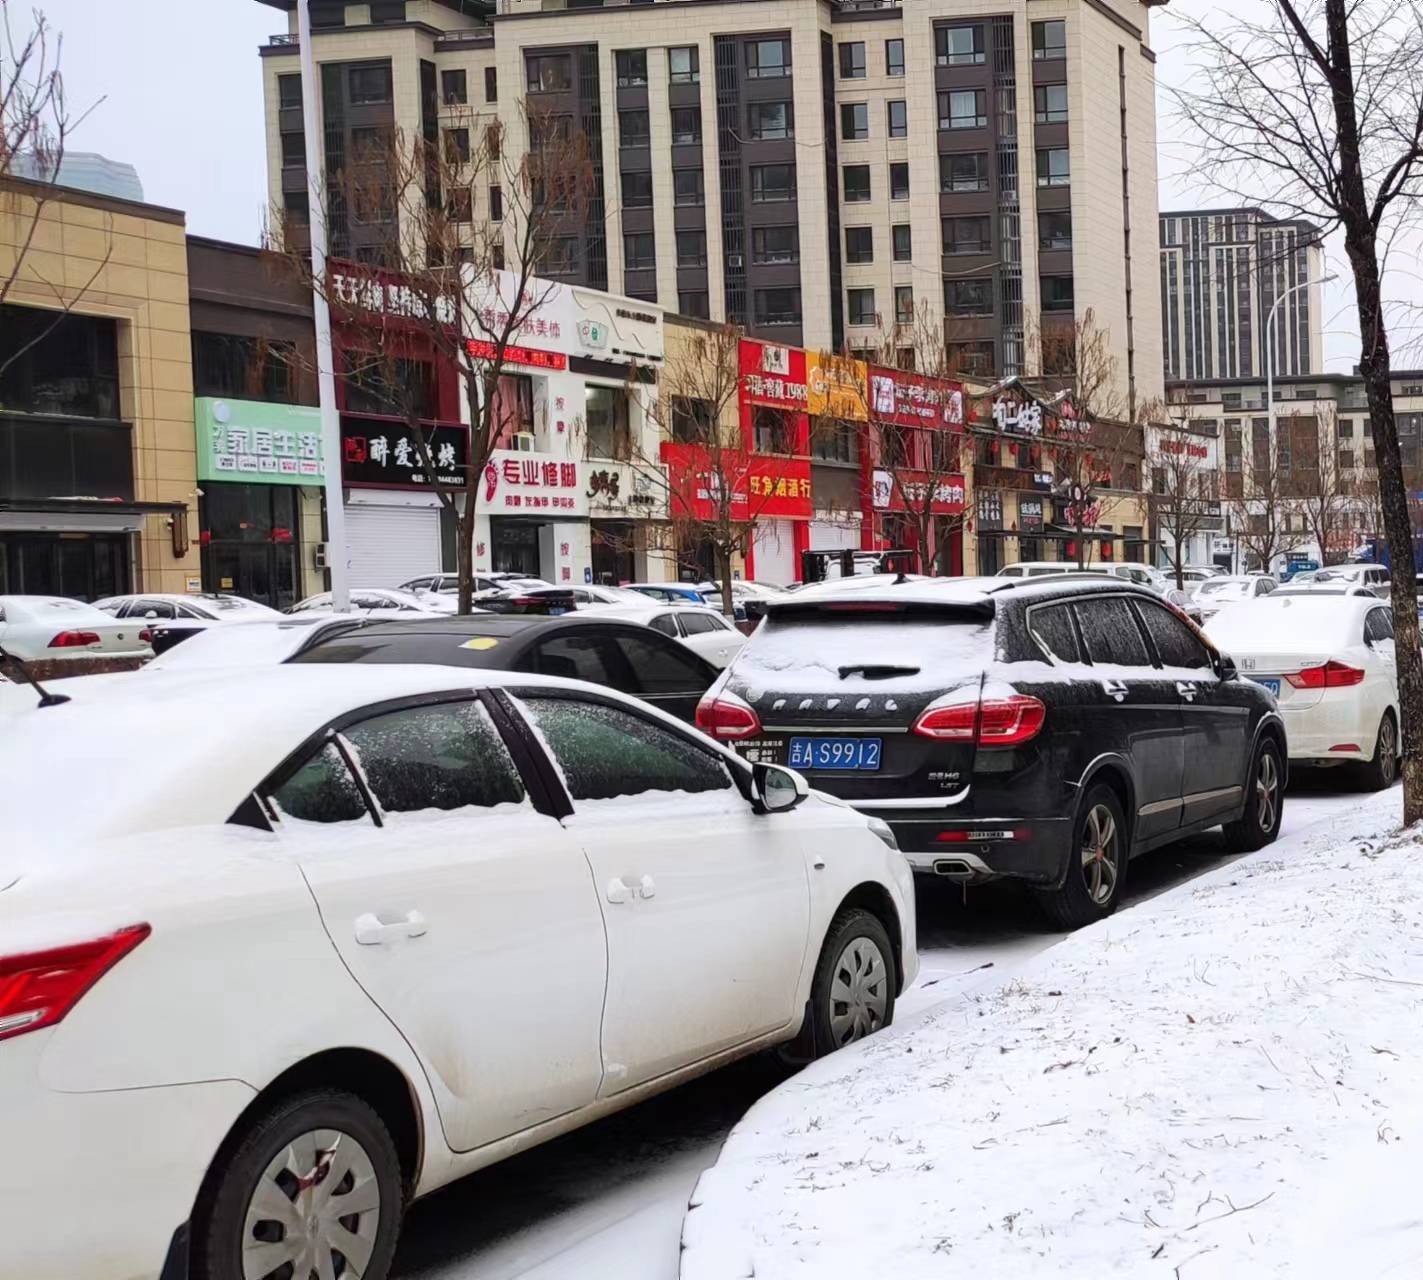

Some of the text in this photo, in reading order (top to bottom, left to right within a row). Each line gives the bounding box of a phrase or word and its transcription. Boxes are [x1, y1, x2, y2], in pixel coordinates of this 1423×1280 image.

[227, 427, 324, 459] 家居生活
[503, 459, 577, 488] 专业修脚
